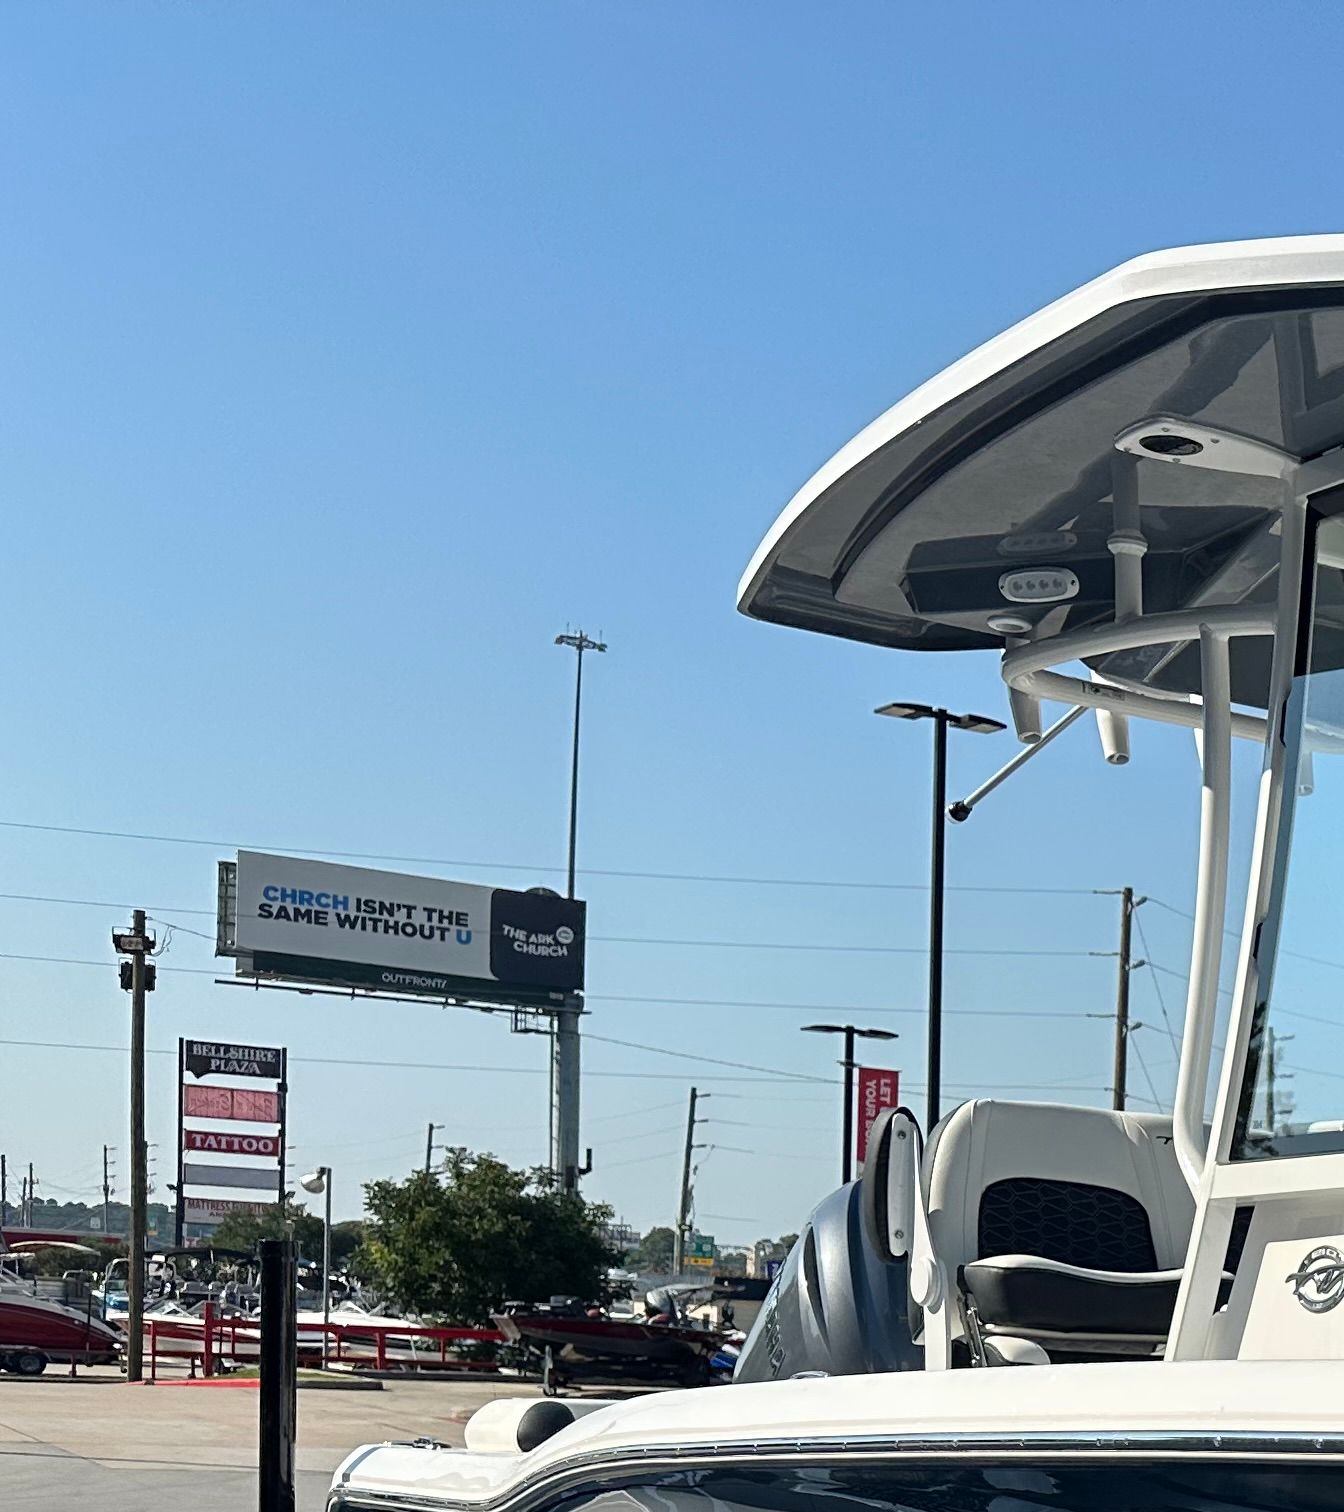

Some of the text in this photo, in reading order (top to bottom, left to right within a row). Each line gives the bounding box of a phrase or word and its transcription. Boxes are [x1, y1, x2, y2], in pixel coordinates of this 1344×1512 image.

[262, 885, 469, 927] CHRCH ISN'T THE
[258, 903, 472, 945] SAME WITHOUT U
[502, 924, 555, 945] THE ARK
[513, 941, 568, 957] CHURCH
[193, 1044, 276, 1063] BELLSHIRE
[210, 1058, 260, 1074] PLAZA
[866, 1080, 877, 1119] YOUR
[880, 1078, 892, 1105] LET
[192, 1134, 273, 1153] TATTOO
